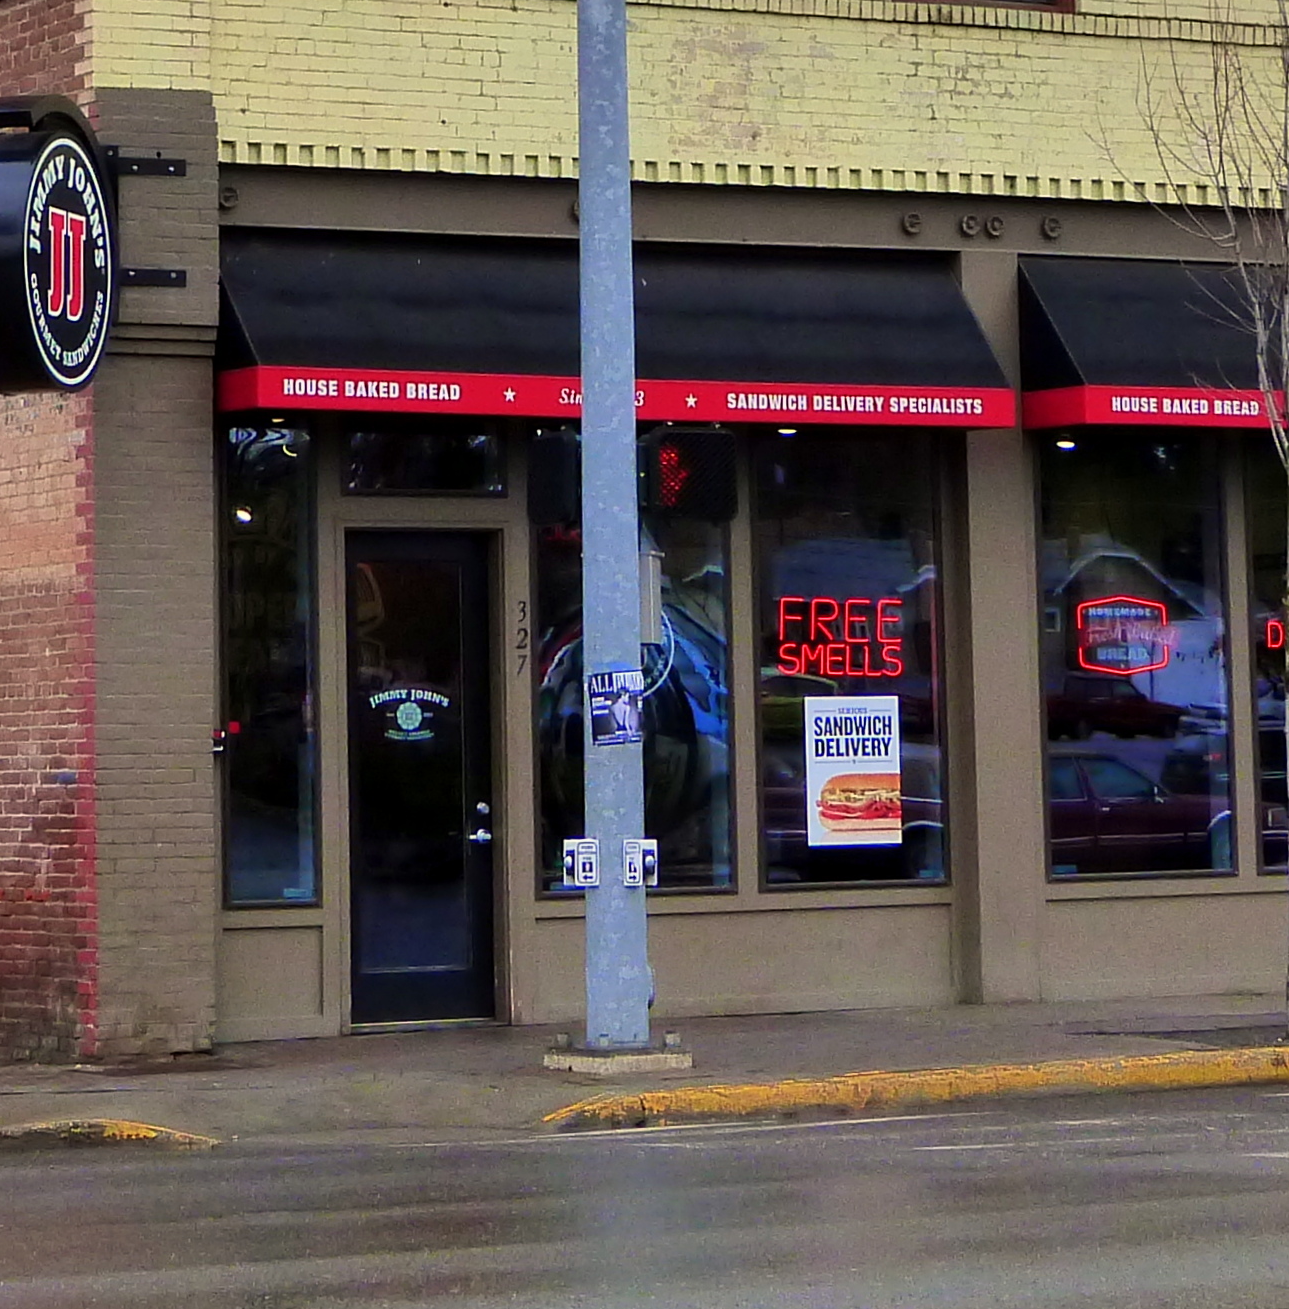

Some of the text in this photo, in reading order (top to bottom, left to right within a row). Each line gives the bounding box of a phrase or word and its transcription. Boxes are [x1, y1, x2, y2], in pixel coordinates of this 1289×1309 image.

[29, 154, 106, 269] JIMMY JOHN'S
[48, 206, 87, 322] JJ
[30, 272, 105, 368] GOURMET SANDWICHES
[283, 378, 583, 405] HOUSE BAKED BREAD Sin
[726, 392, 983, 415] SANDWICH DELIVERY SPECIALISTS
[1111, 395, 1158, 413] HOUSE
[1162, 397, 1209, 415] BAKED
[1213, 398, 1260, 416] BREAD
[778, 596, 904, 643] FREE
[515, 599, 529, 677] 327
[776, 643, 904, 677] SMELLS
[369, 688, 450, 709] JIMMY JOHN'S
[837, 707, 868, 716] SERIOUS
[813, 715, 893, 737] SANDWICH
[813, 736, 893, 758] DELIVERY
